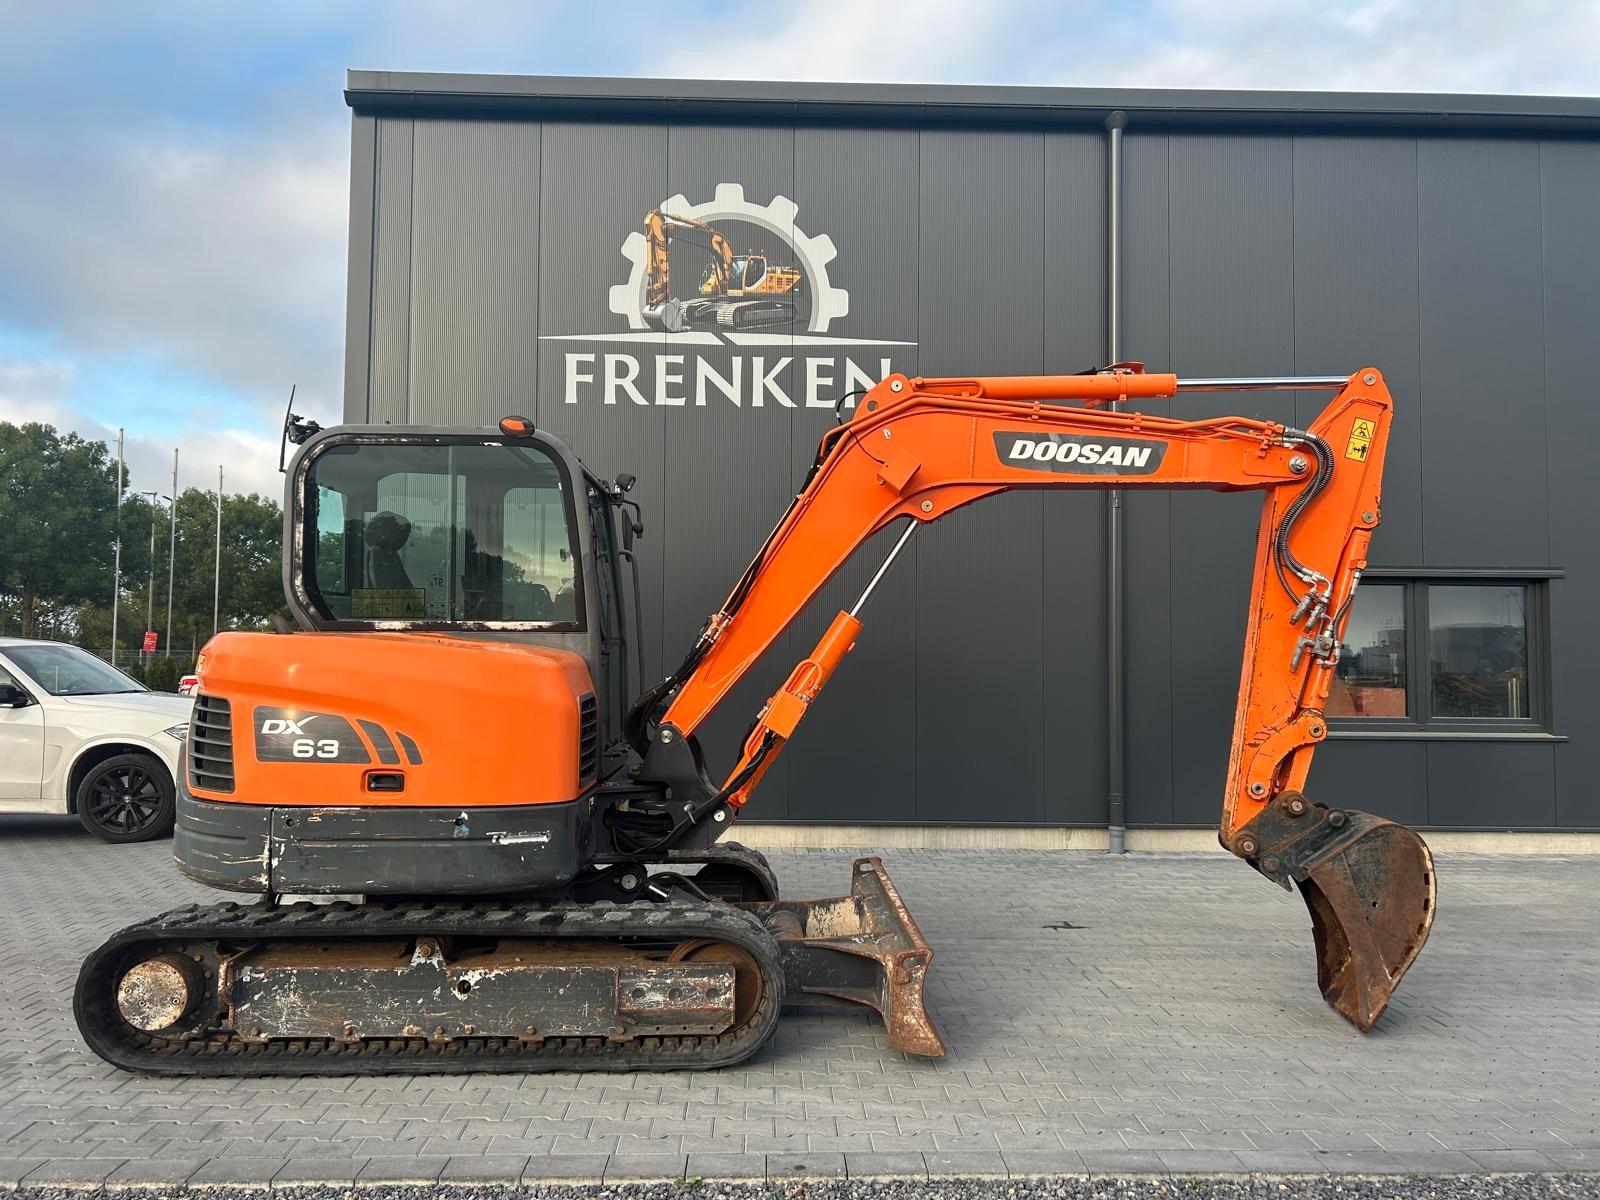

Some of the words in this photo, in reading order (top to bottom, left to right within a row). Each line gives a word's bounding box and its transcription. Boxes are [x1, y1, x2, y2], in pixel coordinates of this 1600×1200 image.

[564, 353, 891, 408] FRENKEN
[1008, 439, 1152, 468] DOOSAN
[261, 715, 319, 735] DX
[292, 738, 340, 759] 63
